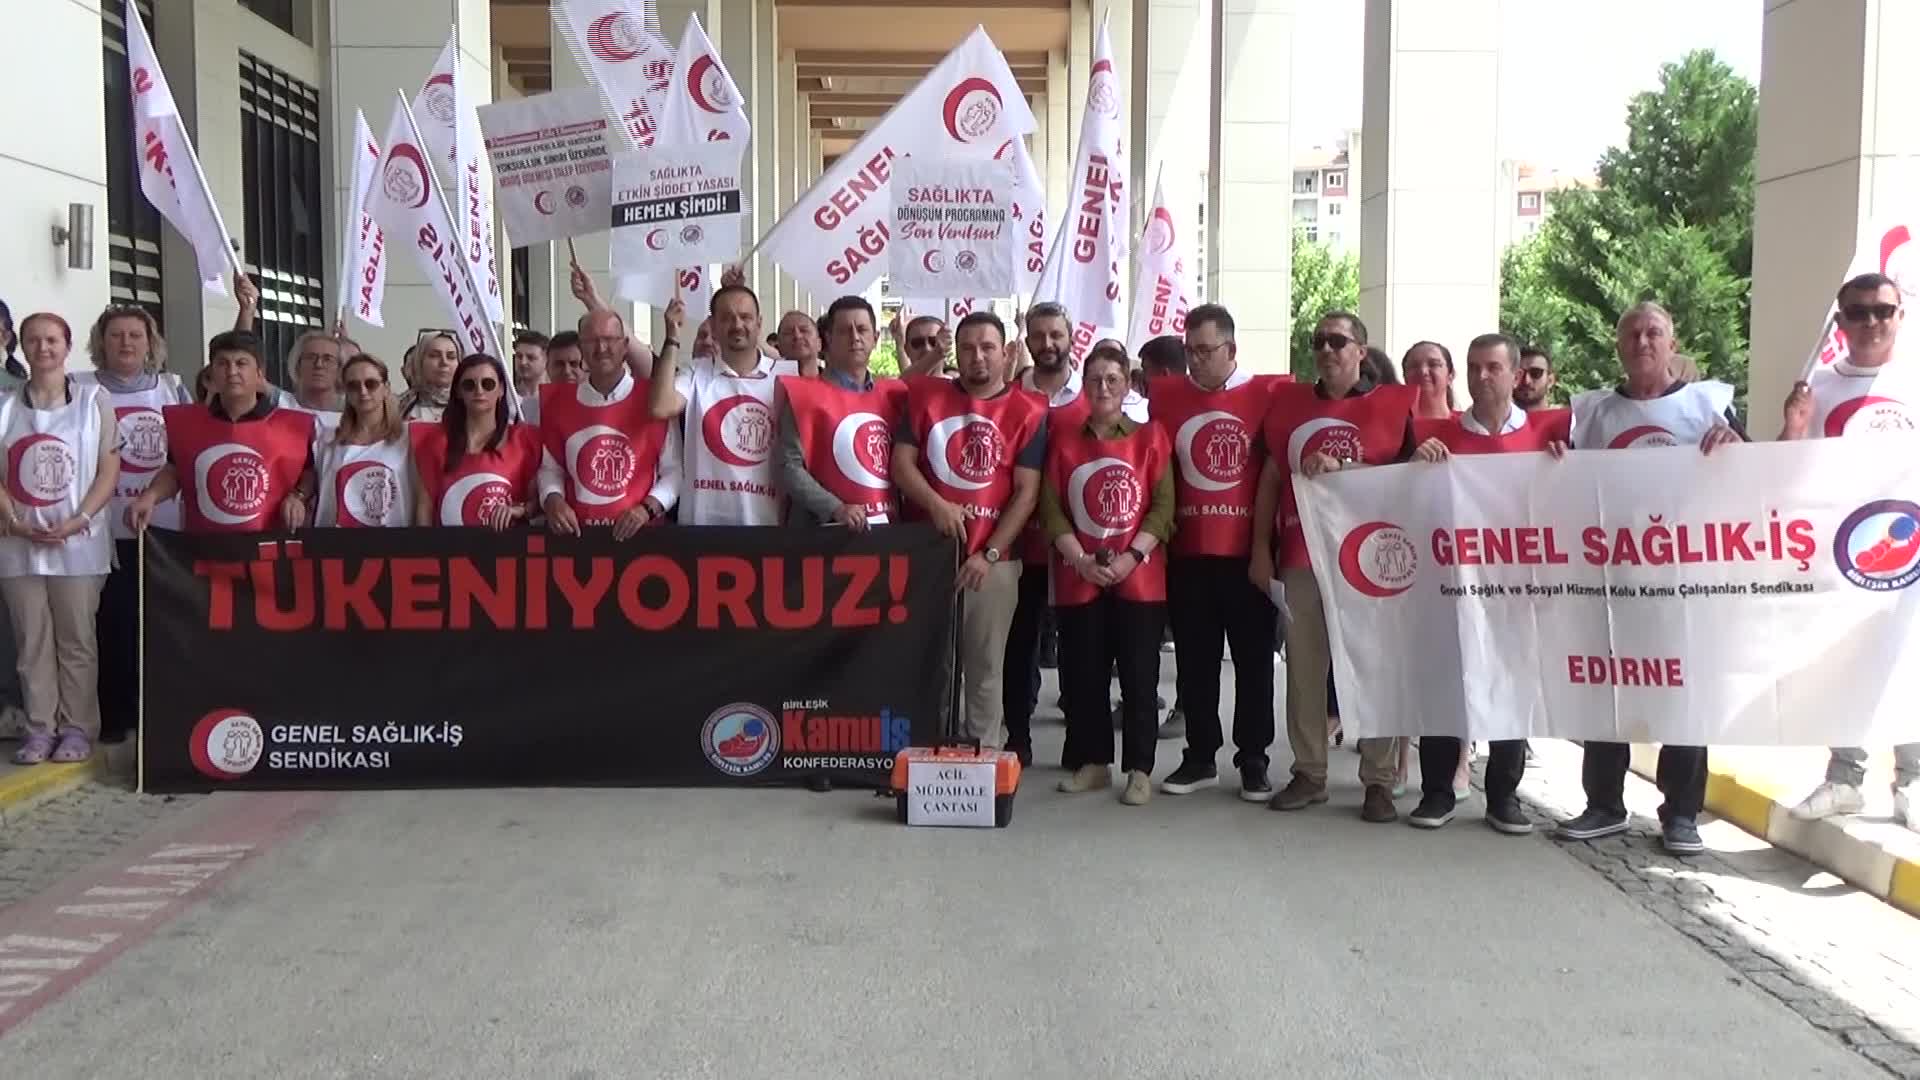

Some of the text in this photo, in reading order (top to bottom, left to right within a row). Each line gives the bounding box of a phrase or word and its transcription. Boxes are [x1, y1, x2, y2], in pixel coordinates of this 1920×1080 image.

[650, 165, 703, 182] SAĞLIKTA
[618, 185, 651, 202] ETKİN
[697, 176, 734, 192] YASASI
[814, 146, 896, 231] GENE
[907, 187, 995, 204] SAĞLIKTA
[624, 192, 727, 223] HEMEN ŞİMDİ!
[897, 206, 943, 223] DÖNÜŞÜM
[899, 221, 934, 241] Son
[693, 479, 727, 491] GENEL
[1431, 509, 1817, 573] GENEL SAĞLIK-İŞ
[194, 535, 911, 632] TÜKENİYORUZ!
[1470, 583, 1505, 598] Sağlık
[1508, 586, 1522, 596] ve
[1525, 583, 1563, 598] Sosyal
[1567, 582, 1608, 598] Hizmet
[1610, 584, 1636, 598] Kolu
[1640, 585, 1675, 598] Kamu
[1679, 582, 1747, 599] Çalışanları
[1751, 581, 1814, 595] Sendikası
[1567, 648, 1684, 688] EDİRNE
[783, 699, 829, 710] BİRLEŞİK
[270, 720, 464, 748] GENEL SAĞLIK-İŞ
[268, 747, 391, 769] SENDİKASI
[783, 756, 894, 769] KONFEDERASYO
[936, 767, 967, 781] ACİL
[915, 784, 986, 797] MÜDAHALE
[923, 801, 978, 815] ÇANTASI
